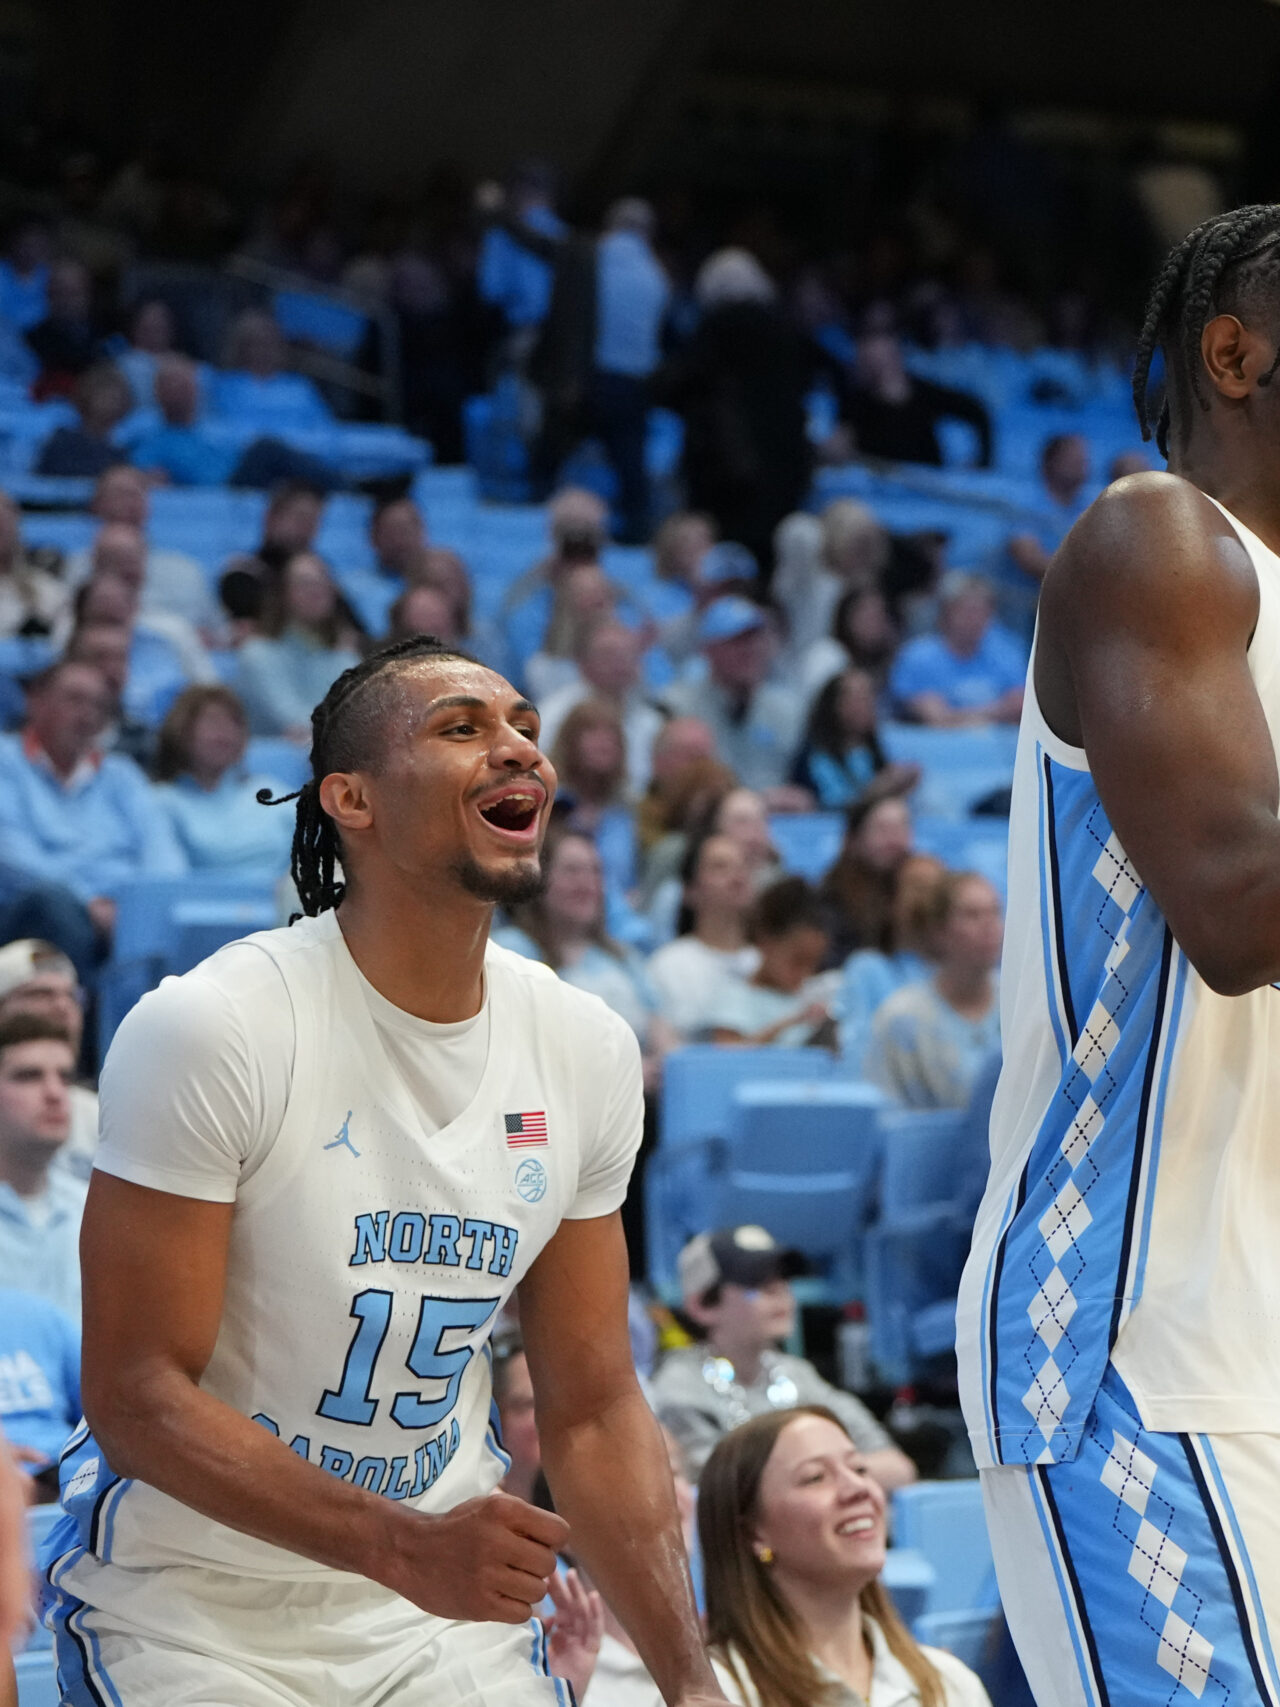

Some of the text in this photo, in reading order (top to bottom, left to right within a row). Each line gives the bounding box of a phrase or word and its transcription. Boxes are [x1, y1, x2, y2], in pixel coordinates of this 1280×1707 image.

[348, 1210, 519, 1277] NORTH
[315, 1288, 501, 1430] 15
[251, 1412, 461, 1501] ROLINA
